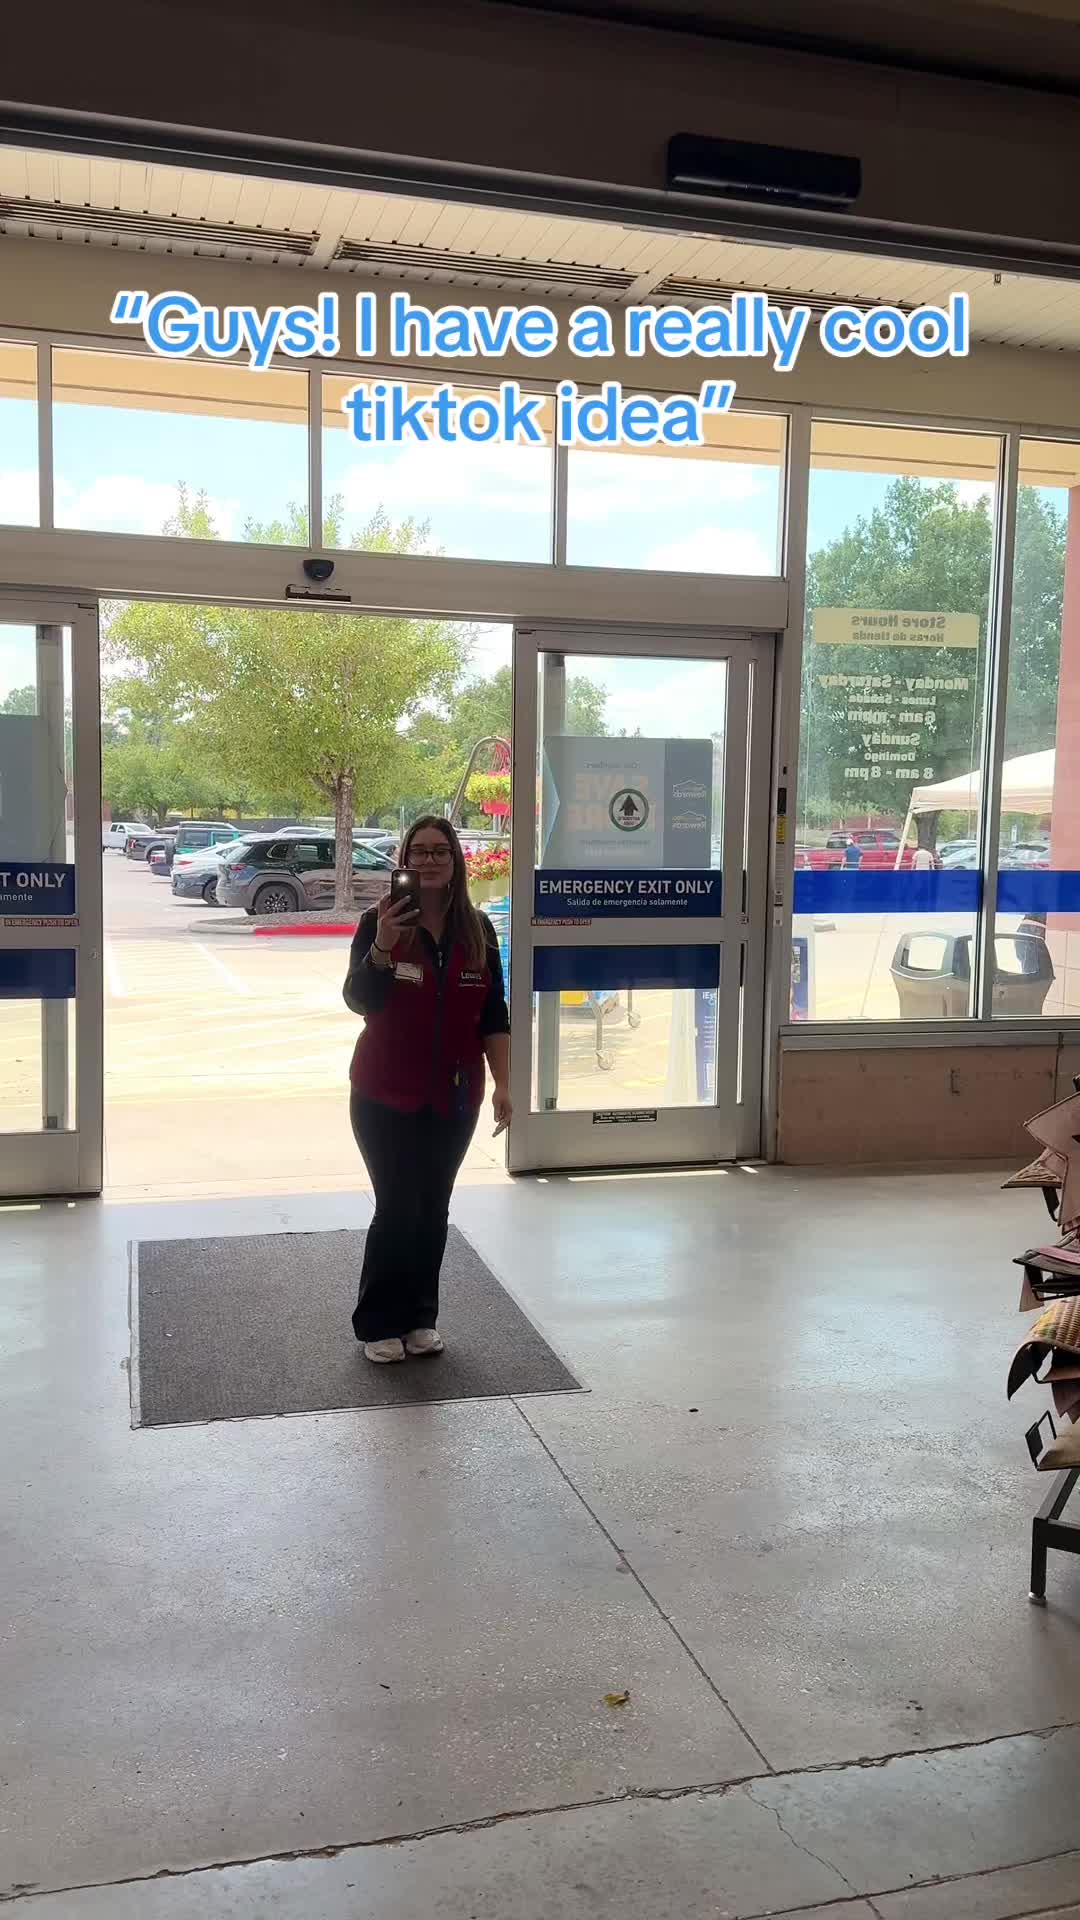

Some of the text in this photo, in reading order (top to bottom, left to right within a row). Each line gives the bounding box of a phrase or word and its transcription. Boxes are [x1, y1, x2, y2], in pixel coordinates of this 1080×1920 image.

[16, 872, 66, 888] ONLY
[539, 880, 714, 894] EMERGENCY EXIT ONLY
[567, 897, 688, 908] Salida de emergencia solamente
